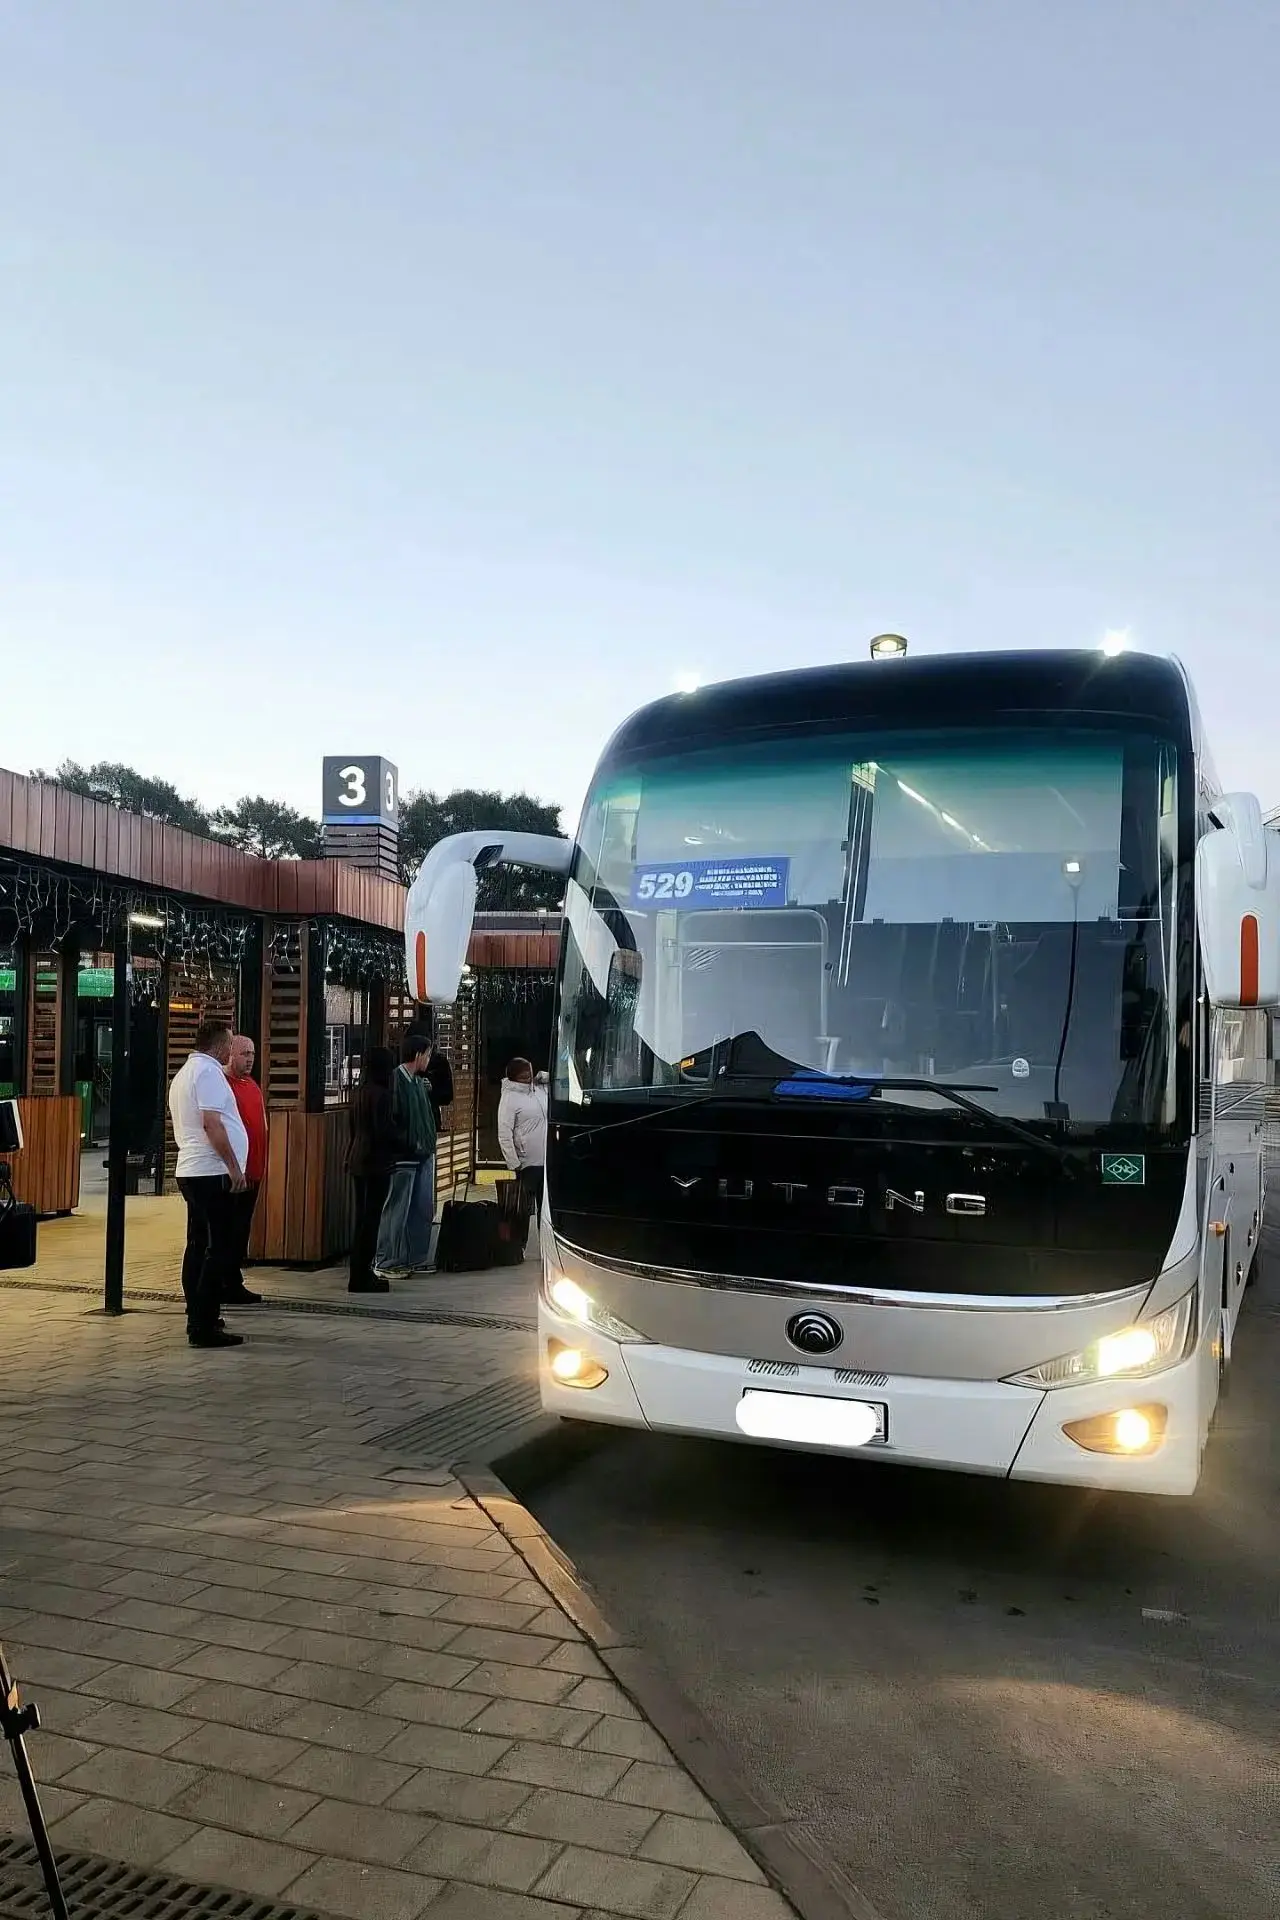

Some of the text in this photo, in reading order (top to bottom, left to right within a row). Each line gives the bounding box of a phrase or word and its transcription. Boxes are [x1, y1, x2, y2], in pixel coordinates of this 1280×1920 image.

[338, 765, 367, 807] 3
[385, 771, 394, 812] 3
[637, 871, 694, 899] 529
[671, 1175, 987, 1216] YUTONG
